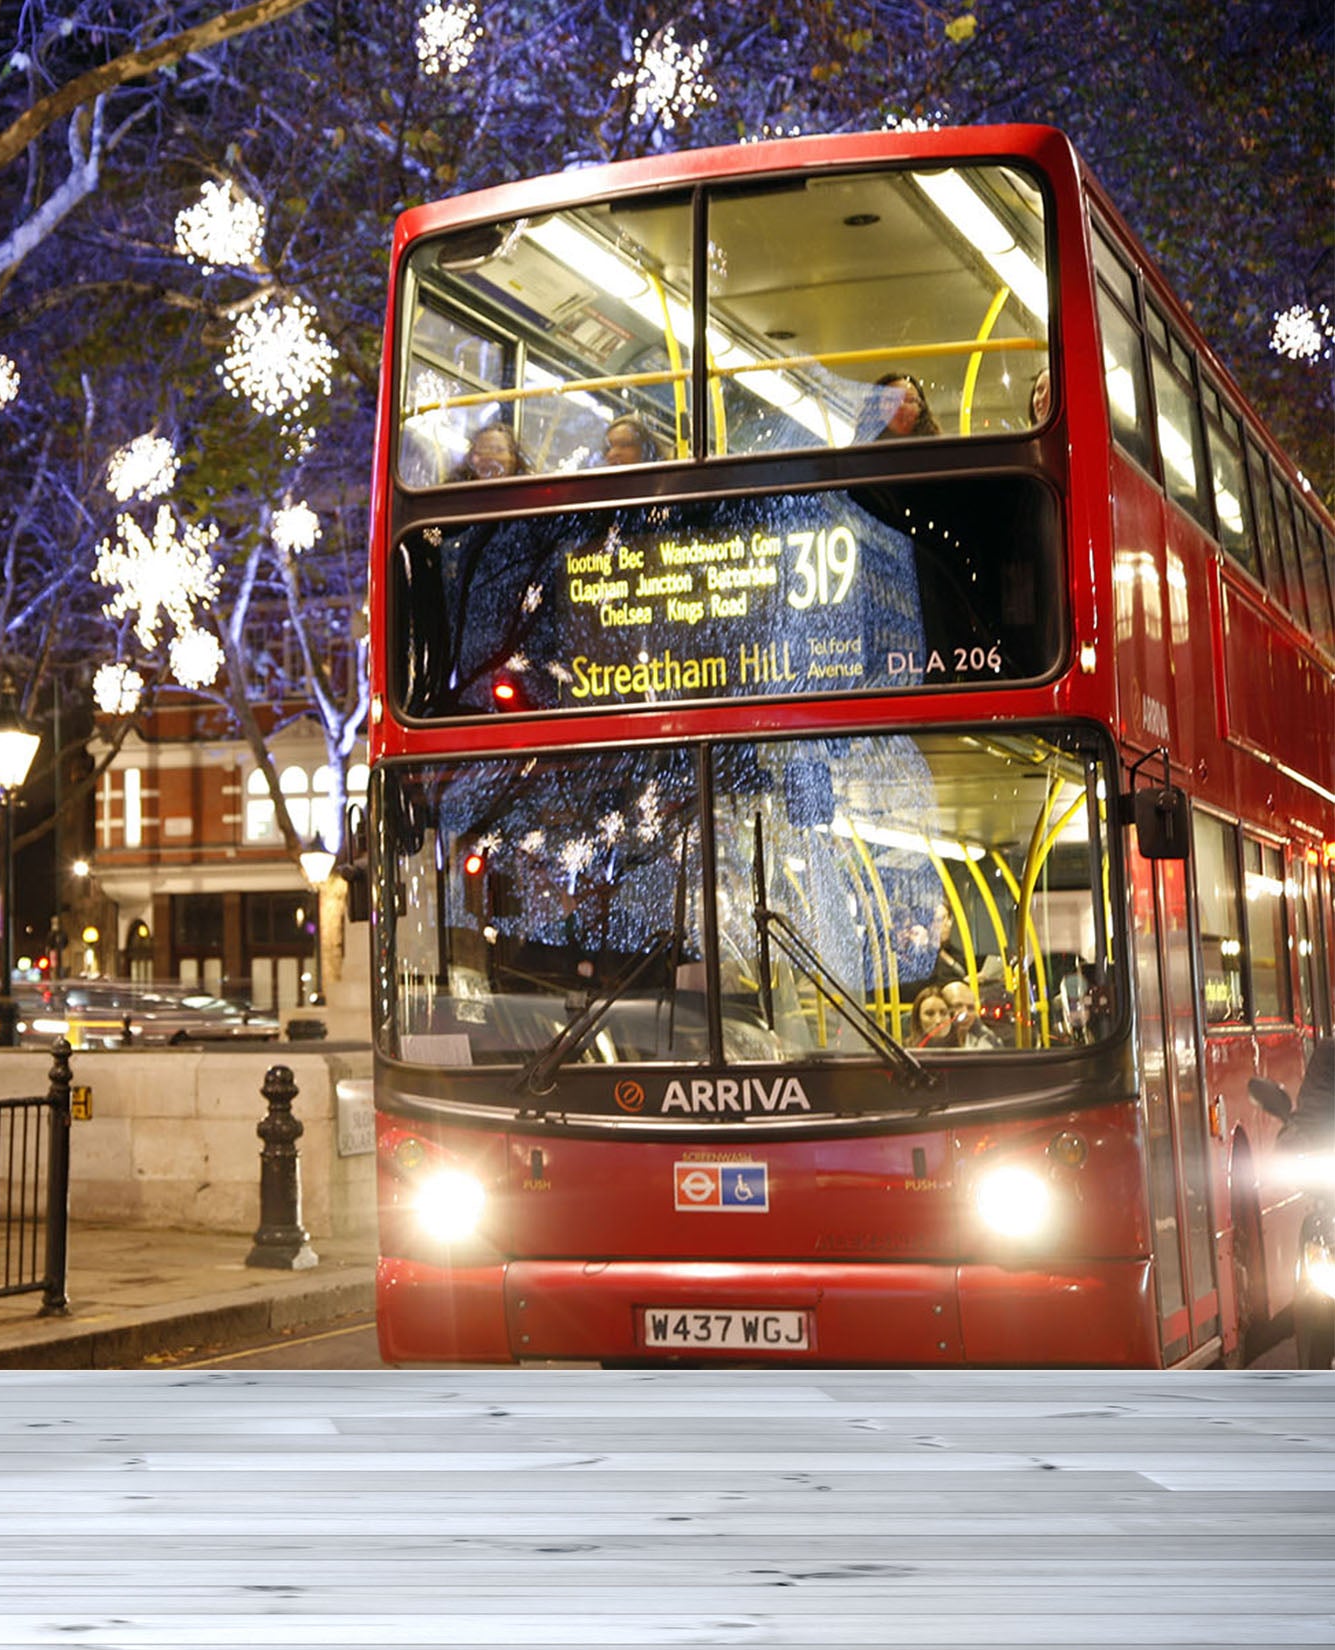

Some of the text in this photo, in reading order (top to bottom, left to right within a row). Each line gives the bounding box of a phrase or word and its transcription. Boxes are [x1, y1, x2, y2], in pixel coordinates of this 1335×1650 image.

[566, 532, 782, 576] Tooting Bec Wandsworth Com
[786, 525, 857, 610] 319
[570, 564, 777, 606] Clapham Junction Battersea
[600, 591, 748, 628] Chelsea Kings Road
[807, 634, 863, 656] Telford
[886, 645, 1003, 676] DLA 206
[571, 640, 797, 698] Streatham Hill
[807, 660, 864, 680] Avenue
[661, 1077, 812, 1113] ARRIVA
[522, 1179, 552, 1191] PUSH
[905, 1179, 937, 1191] PUSH
[651, 1313, 804, 1344] W437 WGJ
